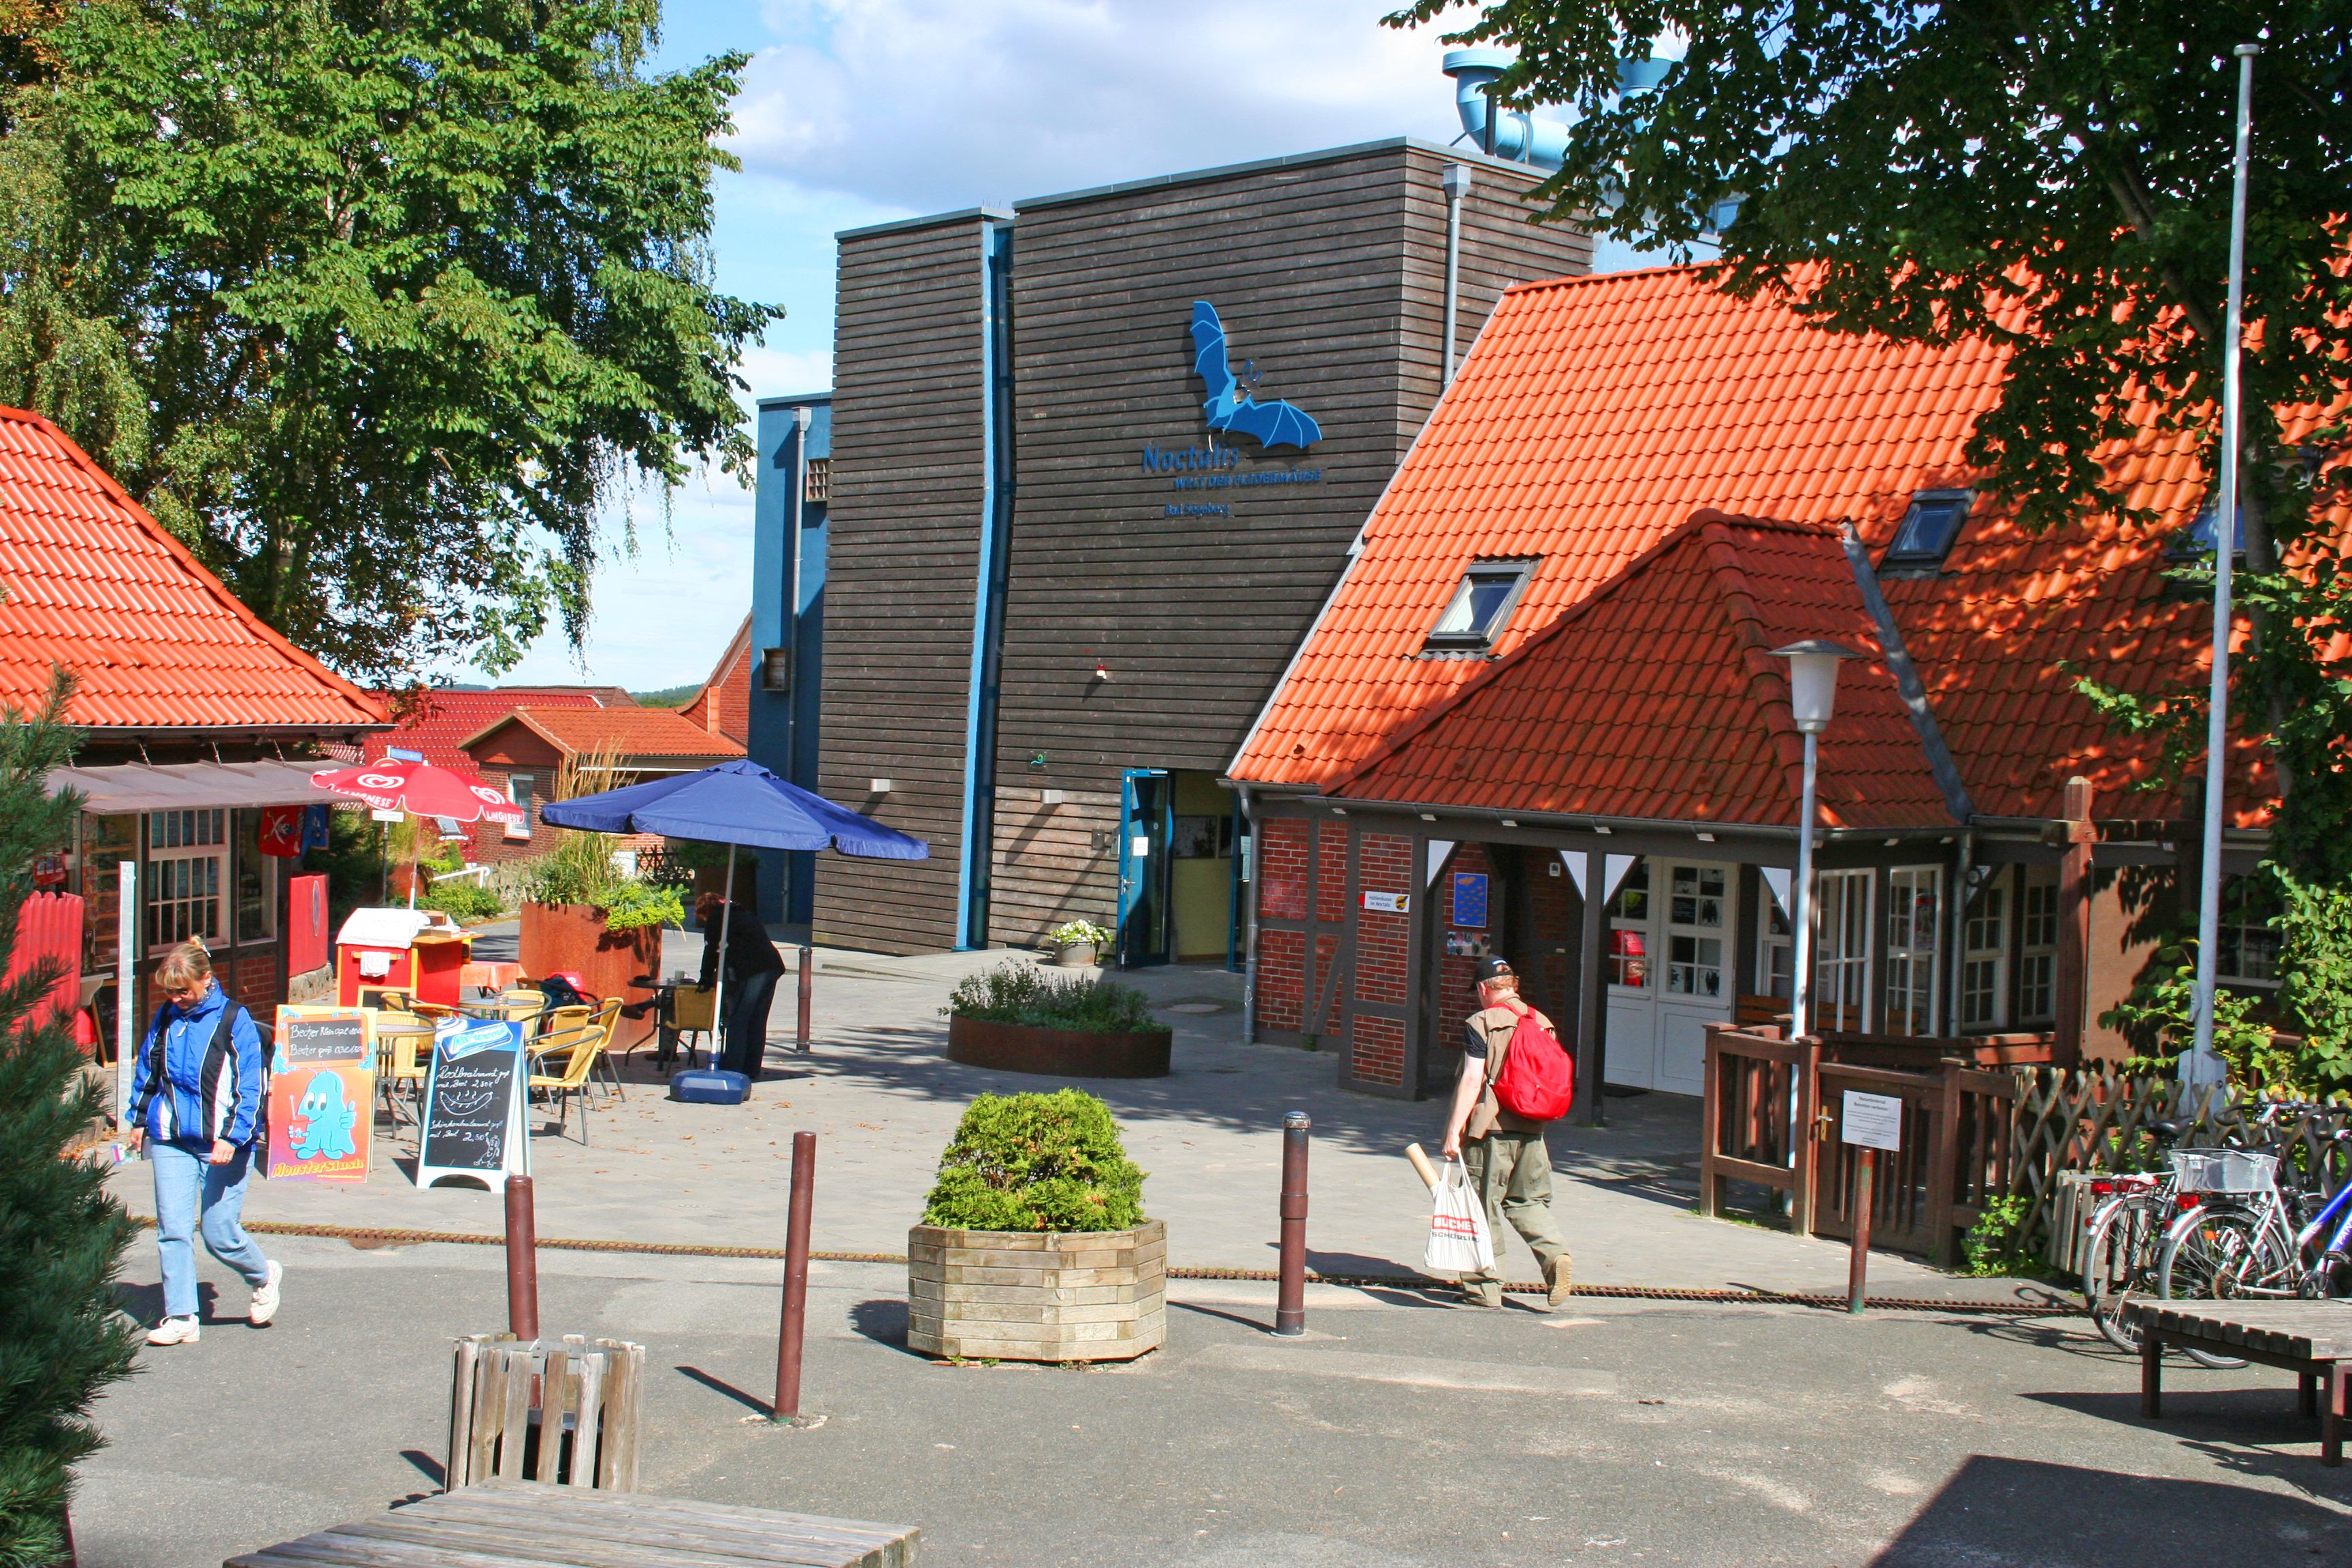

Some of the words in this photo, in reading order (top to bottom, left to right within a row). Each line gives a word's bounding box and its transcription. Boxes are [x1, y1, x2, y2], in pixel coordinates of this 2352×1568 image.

[1142, 442, 1239, 472] Noctalis
[1175, 476, 1205, 489] WELT
[1209, 473, 1230, 487] DER
[1235, 467, 1322, 485] FLEDERMÄUSE
[1165, 504, 1183, 515] Bad
[1186, 502, 1230, 517] Segeberg
[486, 811, 521, 822] LNGESE
[272, 1158, 365, 1178] MonsterSlush
